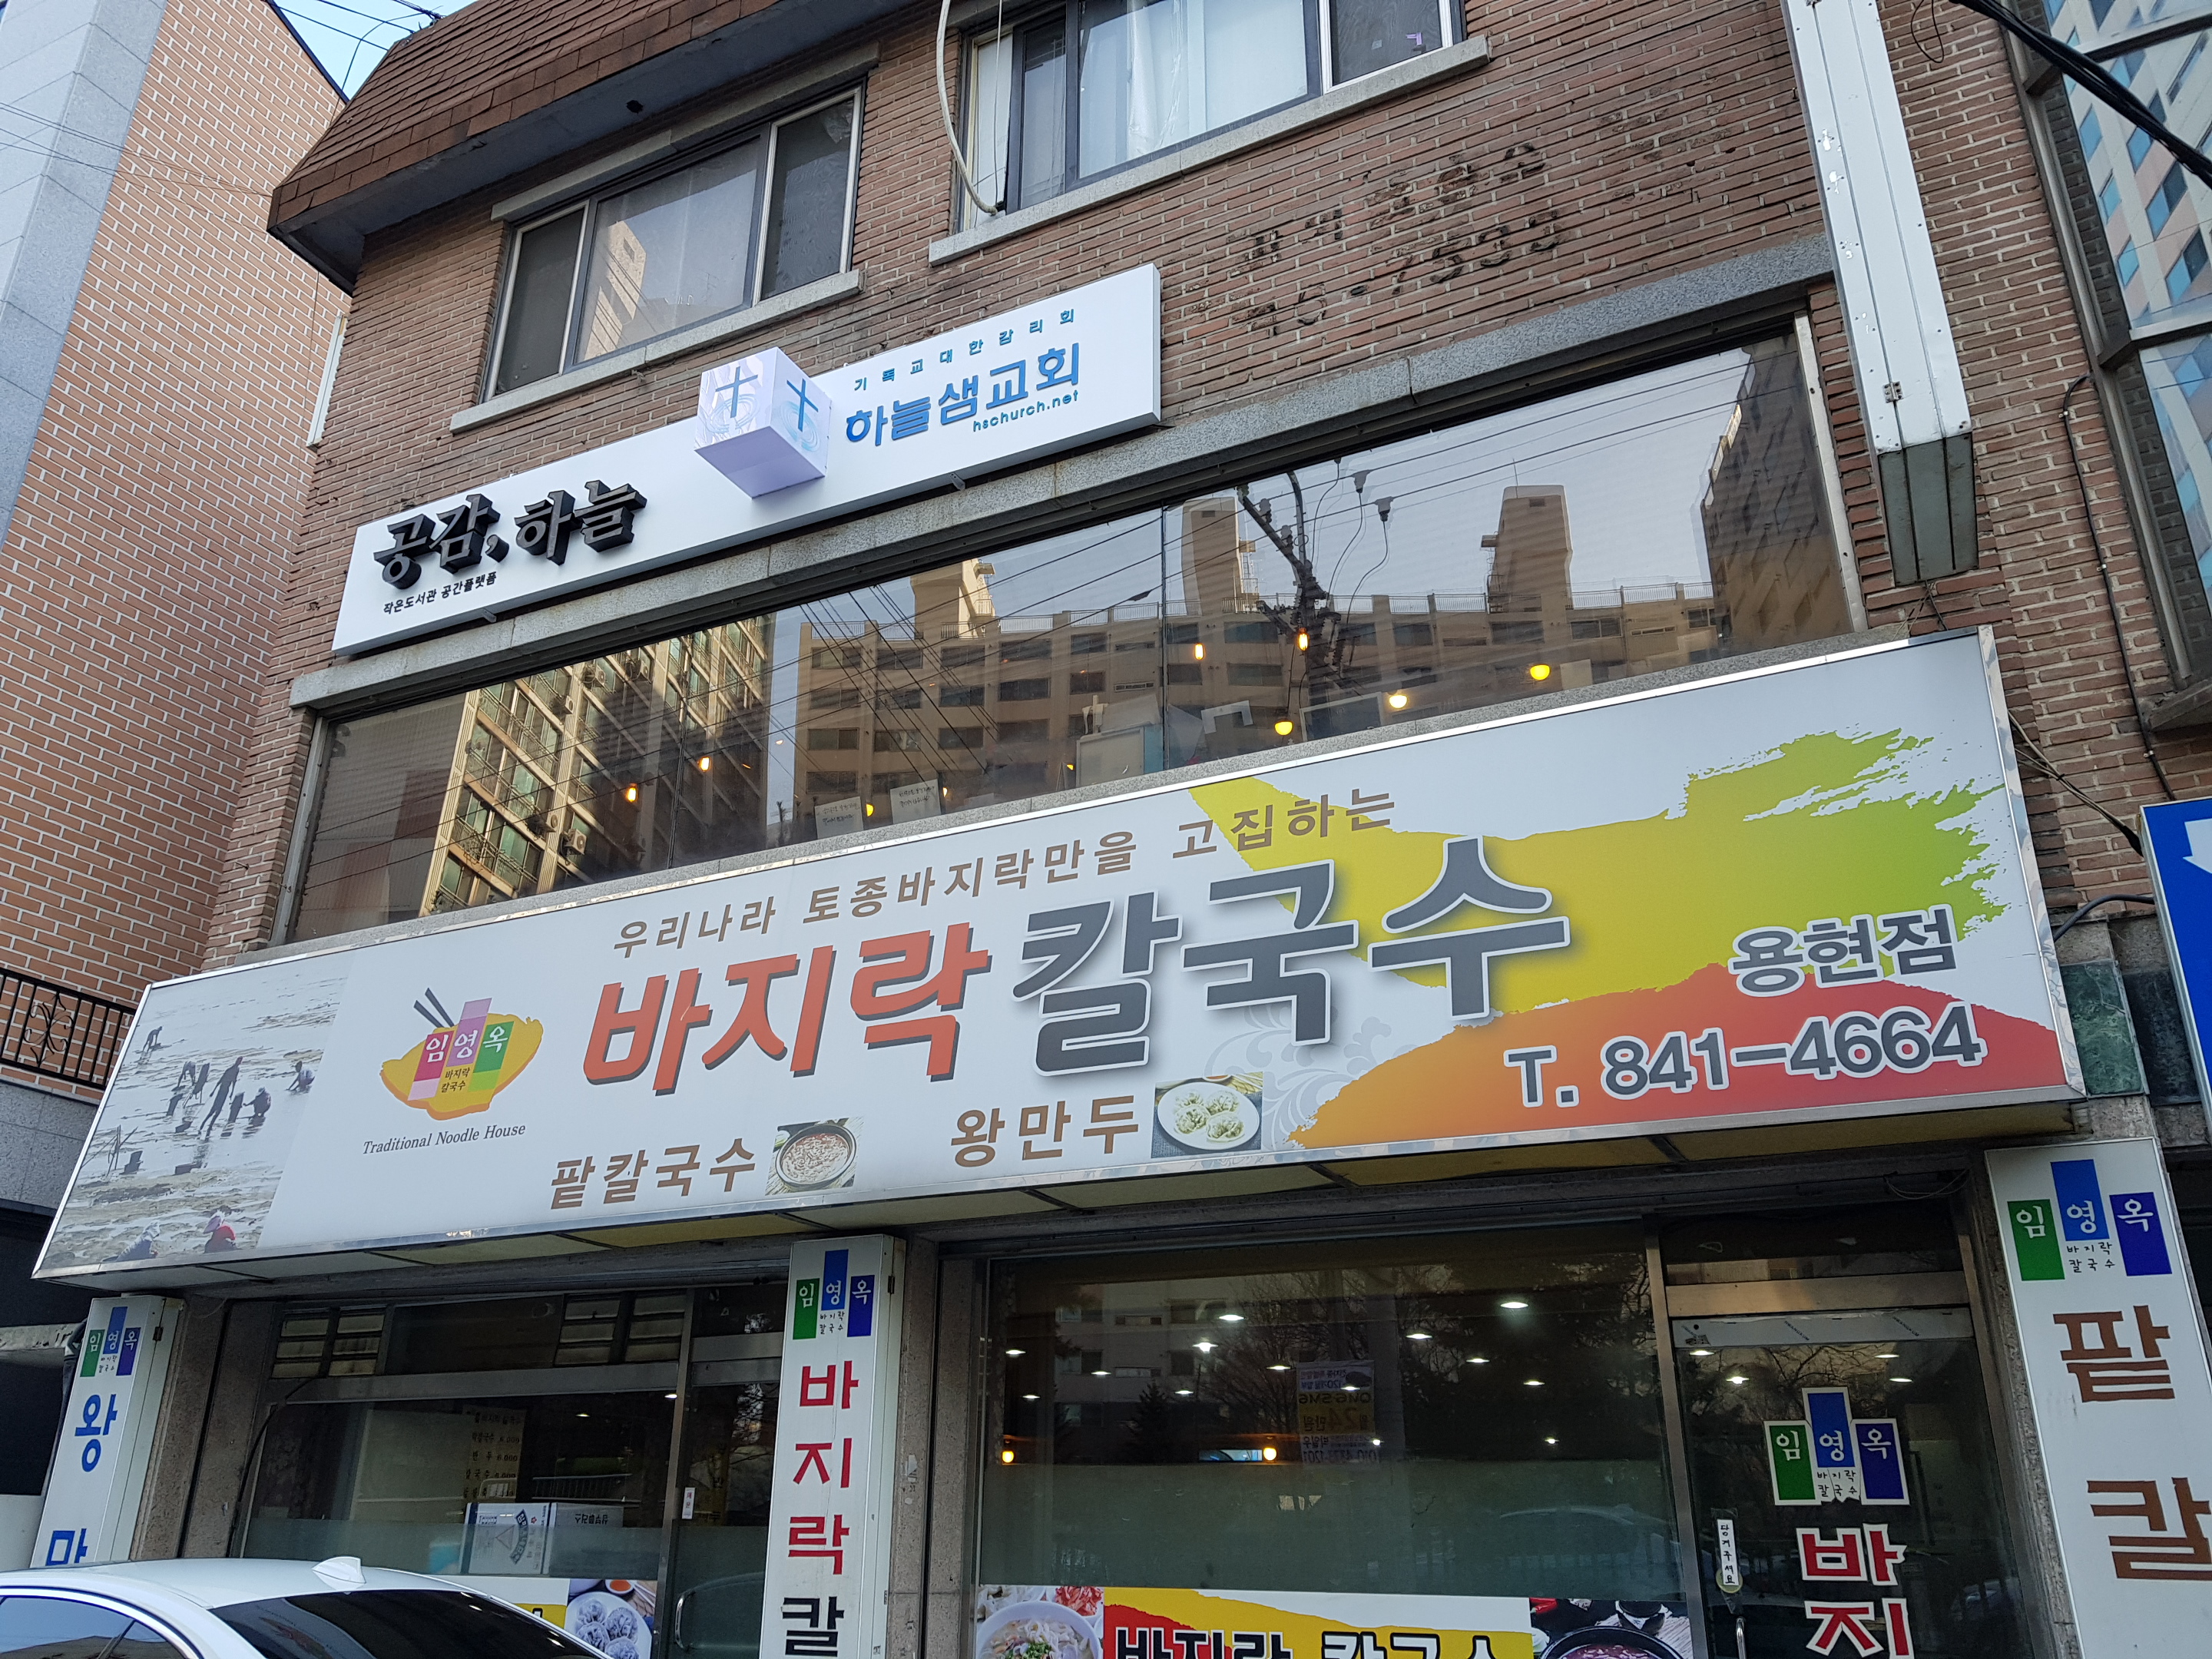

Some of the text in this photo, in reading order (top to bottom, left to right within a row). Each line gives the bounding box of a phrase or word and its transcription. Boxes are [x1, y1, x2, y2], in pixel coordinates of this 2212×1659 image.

[846, 343, 1080, 446] 하늘샘교회
[972, 389, 1079, 432] hschurch.net
[383, 571, 496, 614] 작은도서관 공간플랫폼
[614, 787, 1396, 959] 우리나라 토종바지락만을 고집하는
[1727, 904, 1959, 998] 용현점
[426, 1026, 508, 1063] 임영옥
[1503, 1001, 1988, 1108] T. 841-4664
[441, 1081, 466, 1093] 칼국수
[445, 1067, 471, 1080] 바지락
[363, 1124, 525, 1154] Traditional Noodle House
[950, 1094, 1139, 1168] 왕만두
[551, 1137, 756, 1210] 팥칼국수
[2015, 1198, 2154, 1240] 임영옥
[2066, 1240, 2113, 1257] 바지락
[2068, 1257, 2116, 1273] 칼국수
[799, 1280, 872, 1309] 임영옥
[819, 1323, 844, 1335] 칼국수
[820, 1311, 845, 1321] 바지락
[90, 1330, 137, 1353] 임영옥
[1777, 1429, 1892, 1461] 임영옥
[1817, 1470, 1856, 1482] 바지락
[1818, 1485, 1857, 1497] 칼국수
